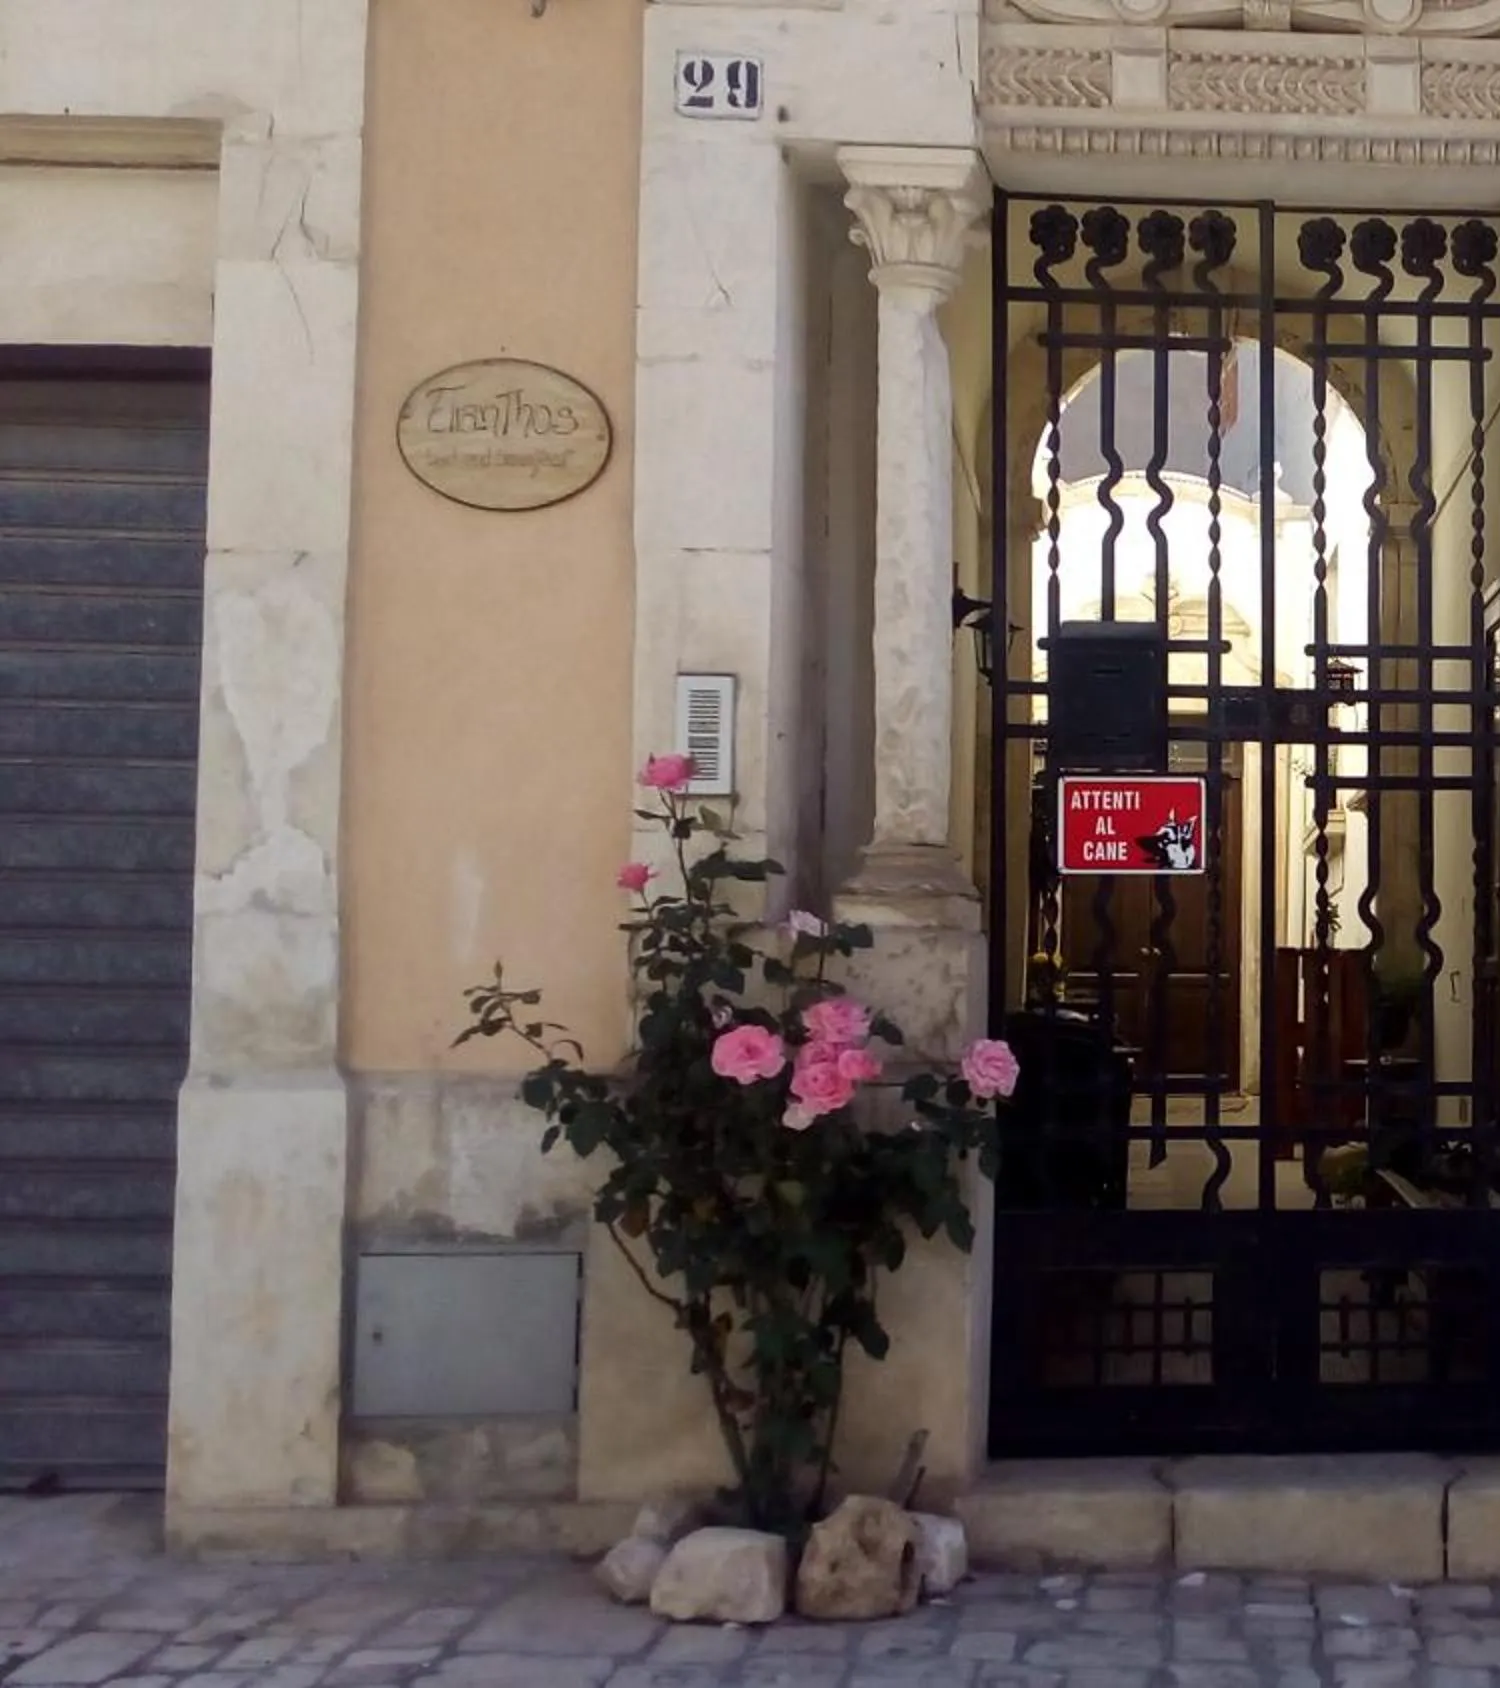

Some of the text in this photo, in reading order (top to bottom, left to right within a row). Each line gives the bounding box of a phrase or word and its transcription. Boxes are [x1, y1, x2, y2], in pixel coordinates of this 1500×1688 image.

[682, 59, 759, 108] 29
[1071, 790, 1141, 810] ATTENTI
[1095, 816, 1117, 835] AL
[1083, 841, 1129, 861] CANE
